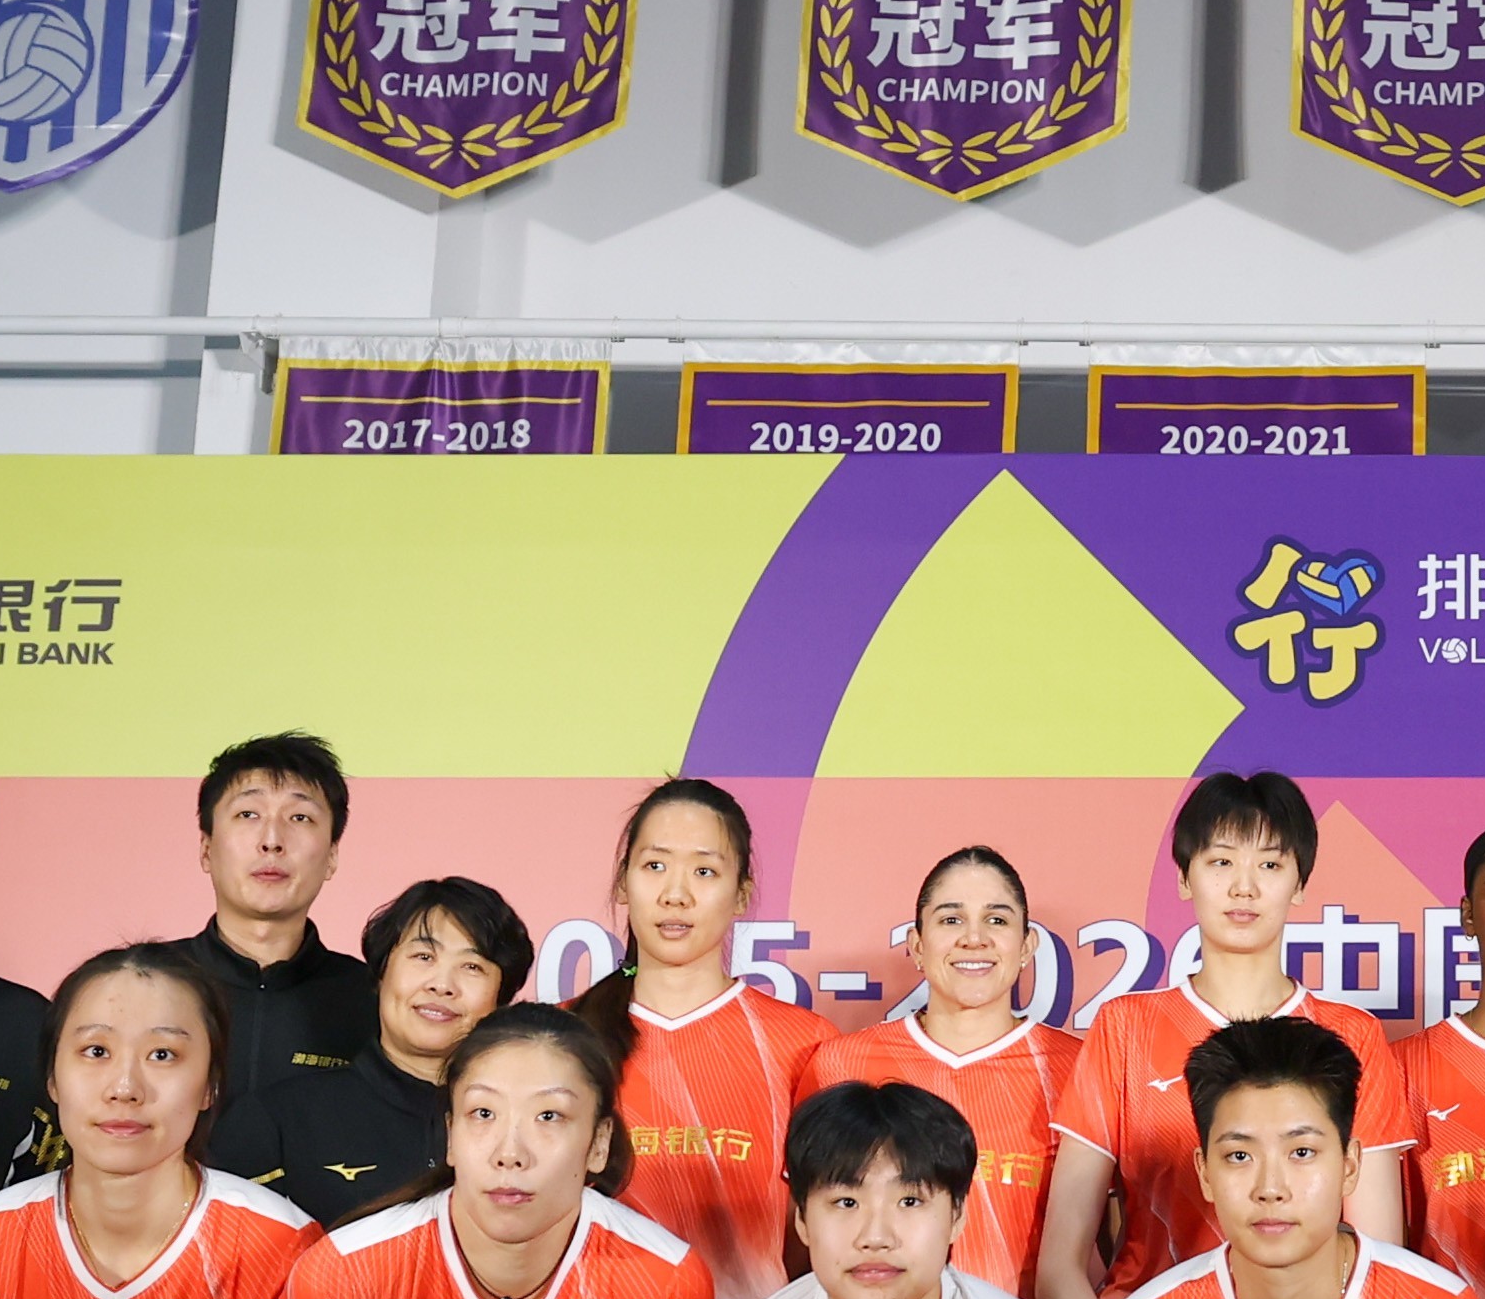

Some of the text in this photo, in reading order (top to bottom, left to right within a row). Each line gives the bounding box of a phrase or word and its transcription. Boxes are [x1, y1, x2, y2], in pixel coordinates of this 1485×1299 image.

[380, 72, 547, 98] CHAMPION
[878, 78, 1045, 103] CHAMPION
[343, 419, 530, 451] 2017-2018
[748, 420, 941, 452] 2019-2020
[1160, 424, 1350, 455] 2020-2021
[17, 642, 114, 665] BANK
[630, 1126, 753, 1161] 海银行
